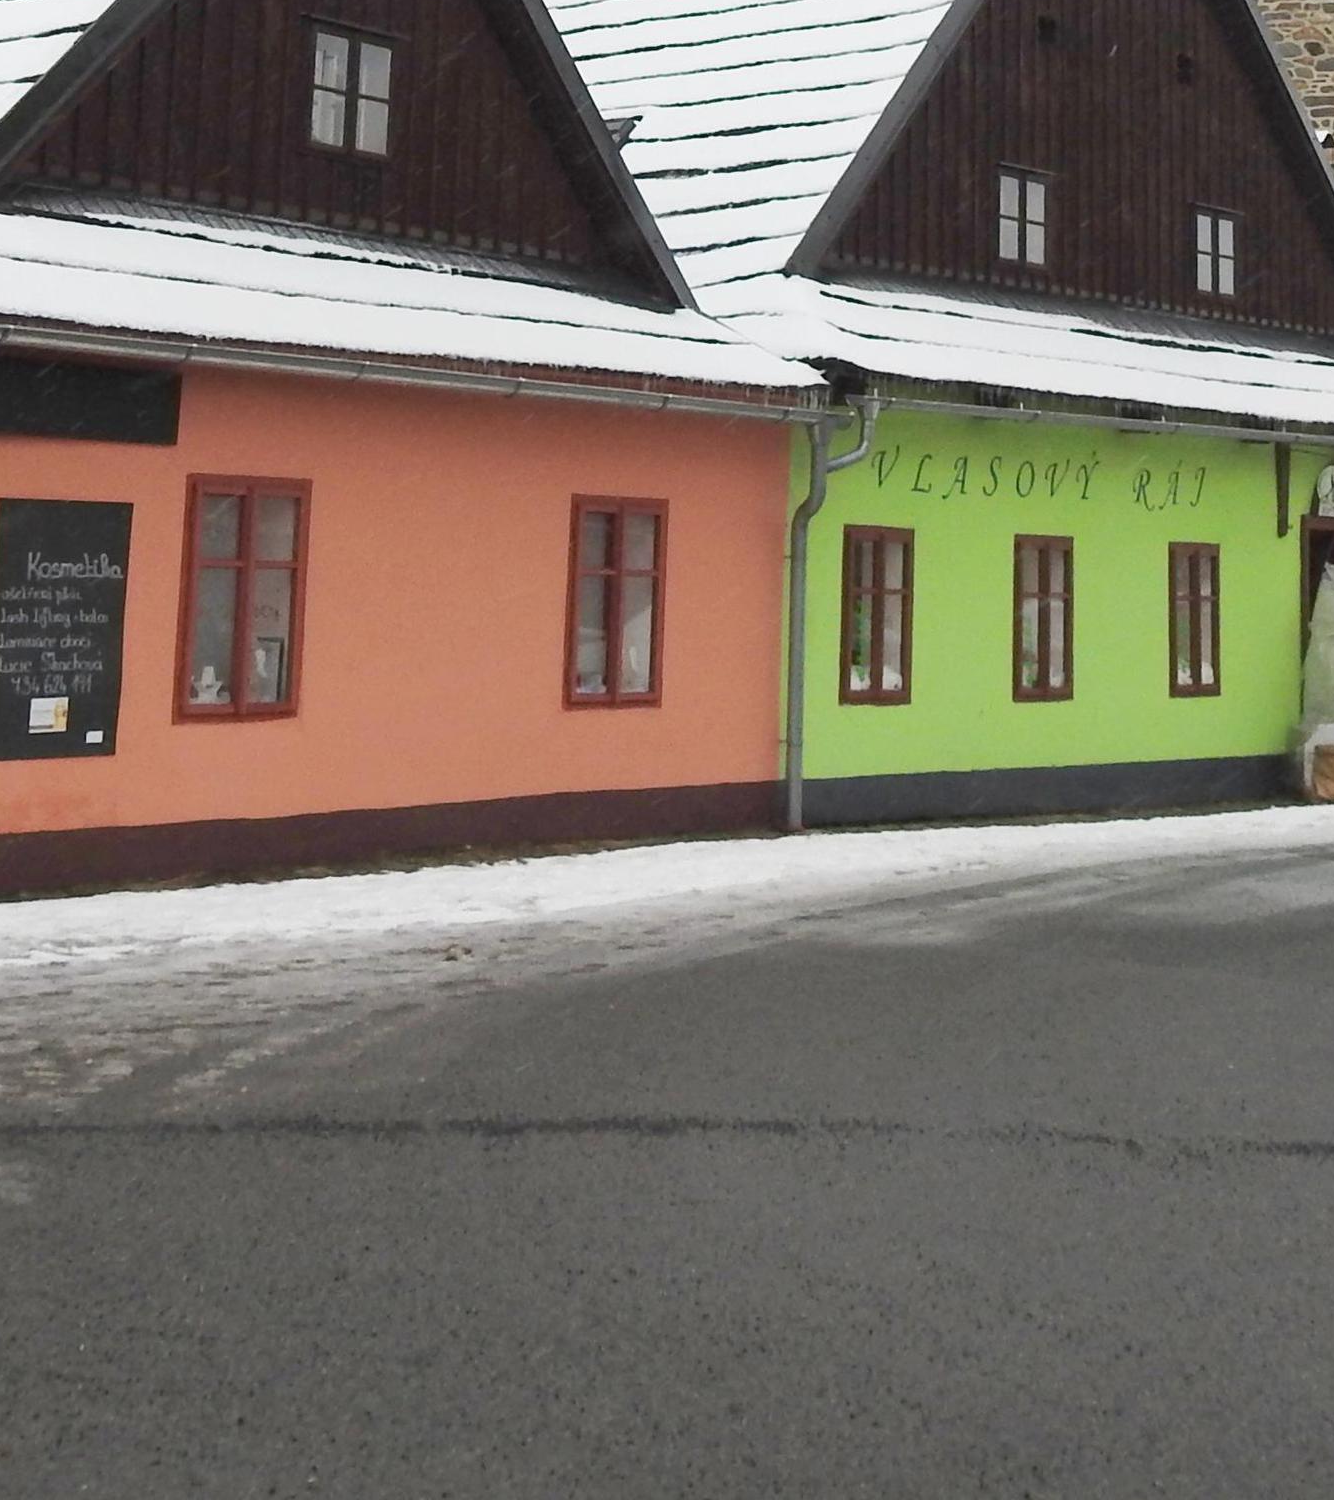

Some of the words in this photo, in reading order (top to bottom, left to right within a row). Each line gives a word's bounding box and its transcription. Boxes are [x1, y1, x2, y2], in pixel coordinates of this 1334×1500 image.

[871, 445, 1100, 500] VLASOVÝ
[1131, 458, 1207, 512] RÁJ
[27, 551, 124, 581] Kosmetika
